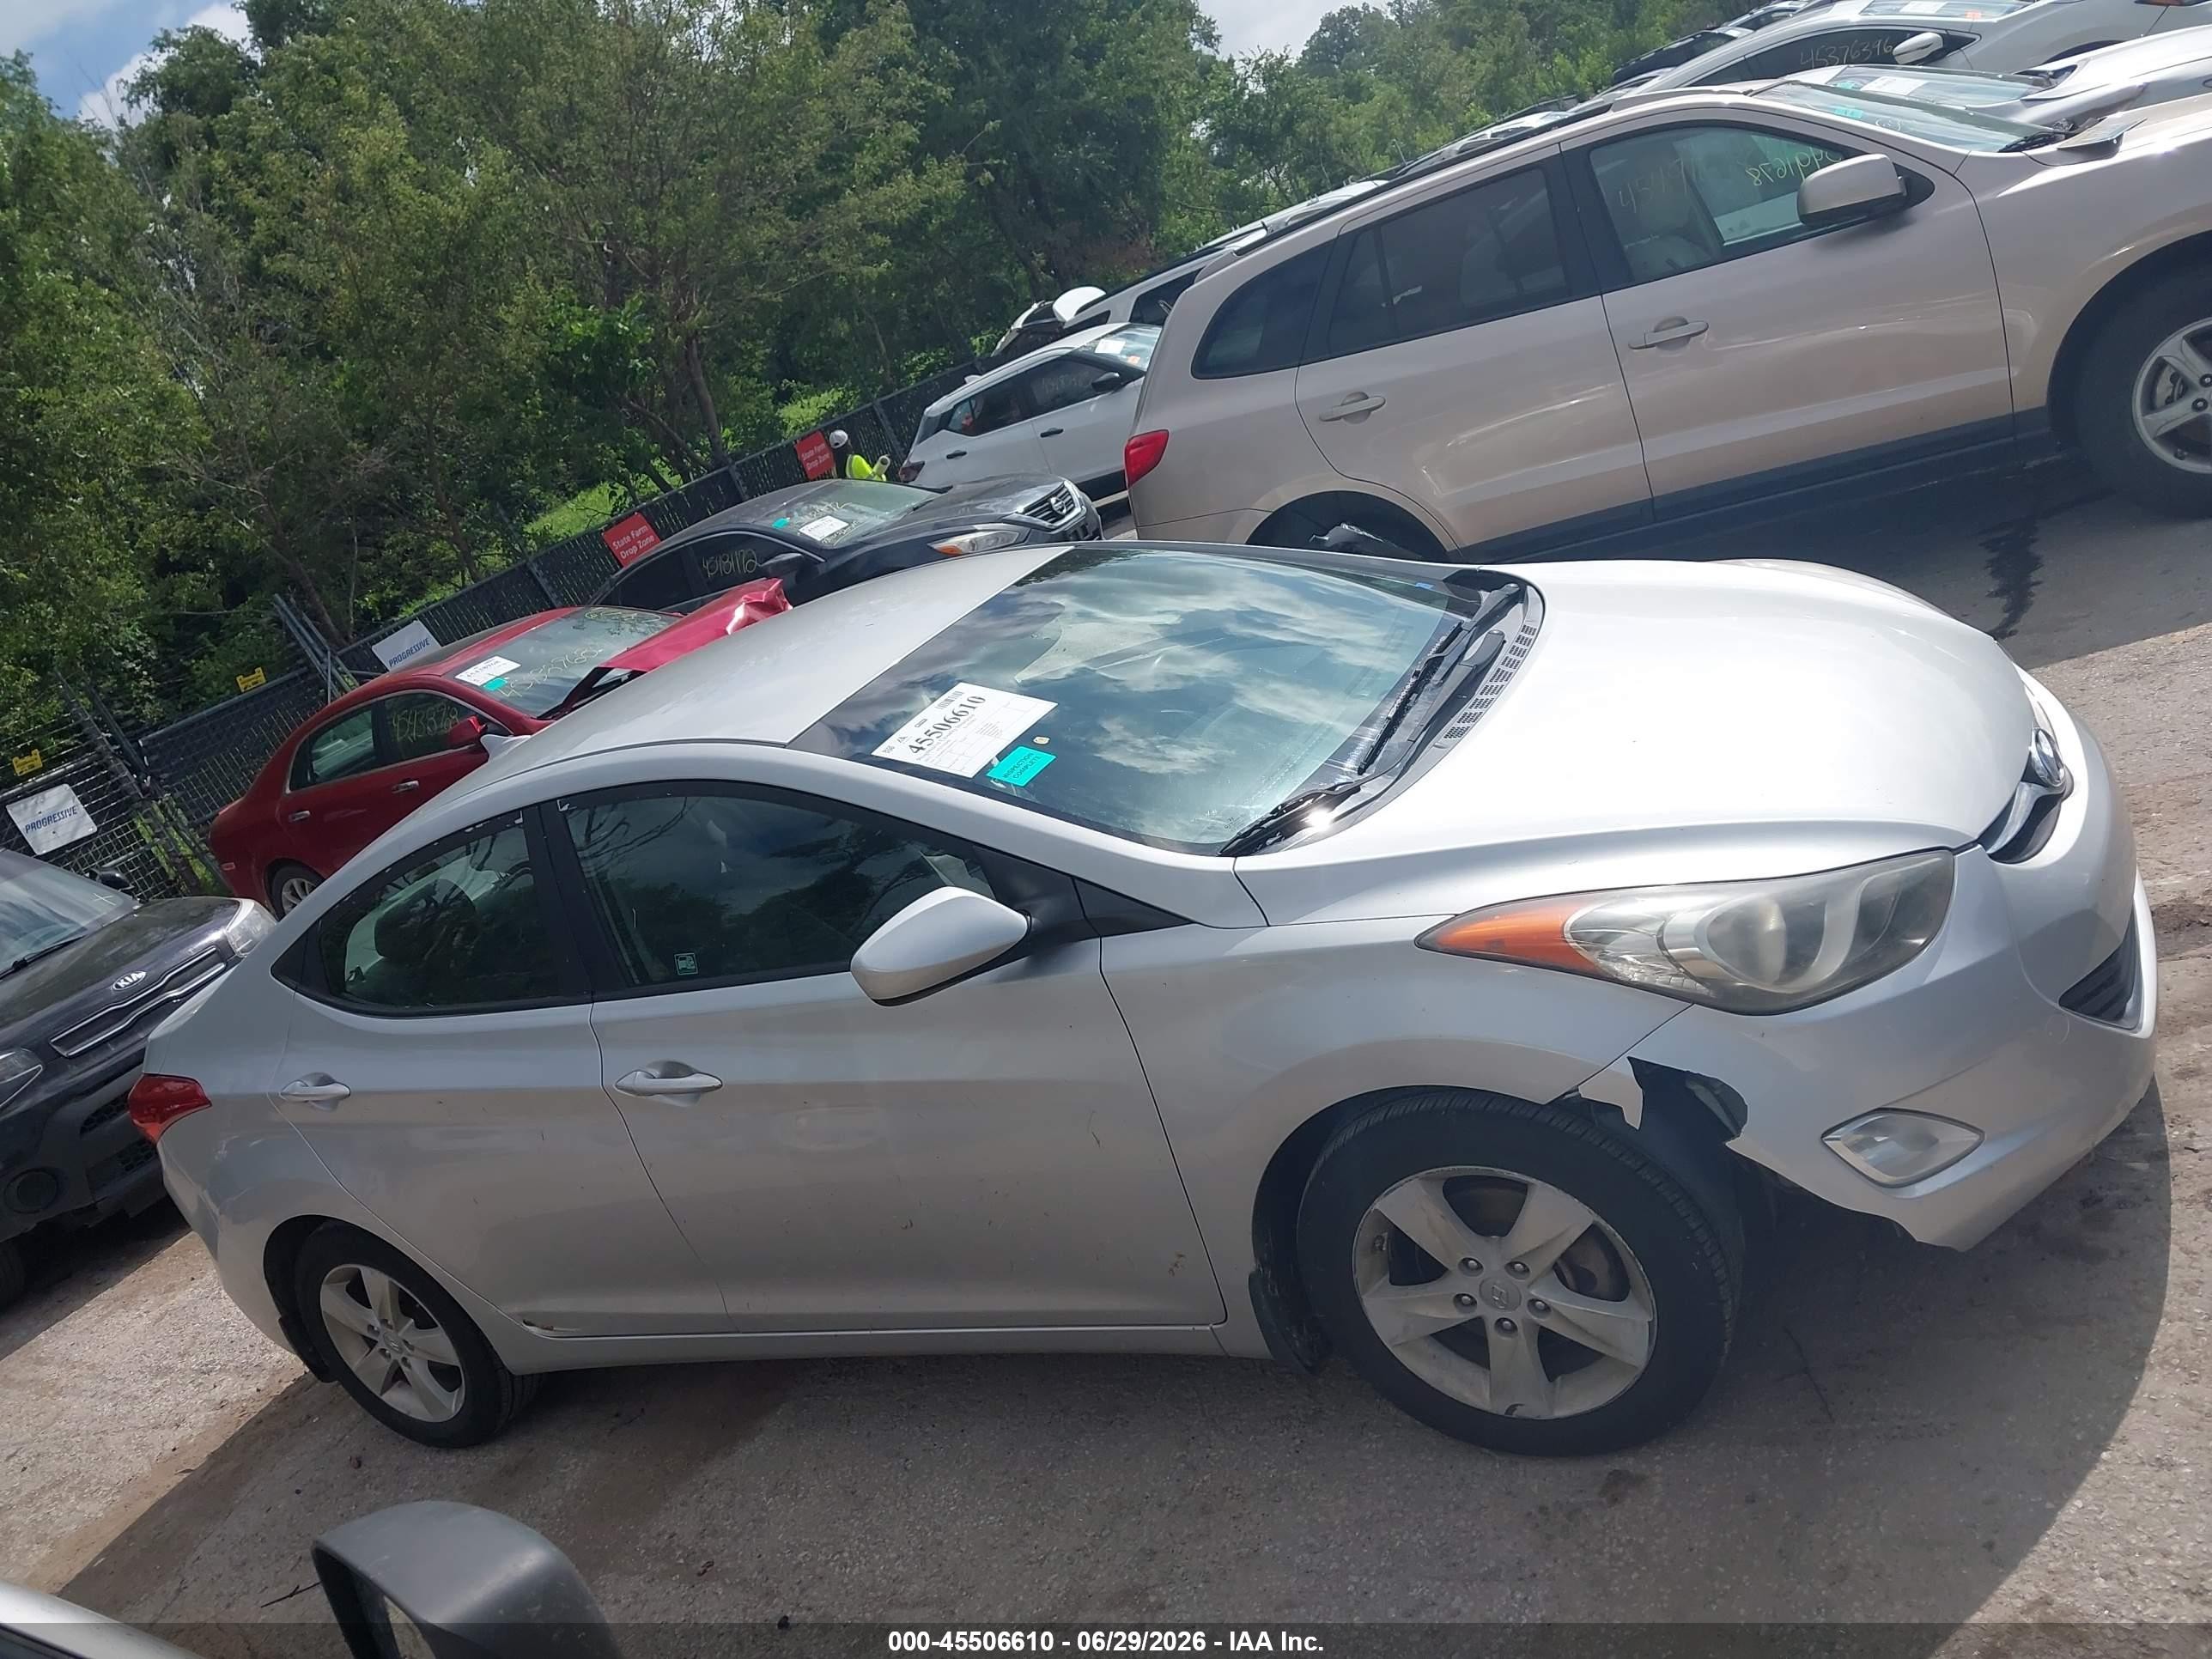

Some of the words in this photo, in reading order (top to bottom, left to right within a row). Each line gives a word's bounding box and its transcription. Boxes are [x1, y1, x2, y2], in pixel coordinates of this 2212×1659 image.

[613, 532, 631, 550] State
[631, 525, 647, 539] Farm
[620, 545, 638, 559] Drop
[638, 534, 655, 549] Zone
[388, 637, 430, 668] PROGRESSIVE
[908, 695, 987, 755] 45506610
[1012, 755, 1041, 779] COMPLETE
[24, 805, 78, 834] PROGRESSIVE
[116, 970, 146, 988] KIA
